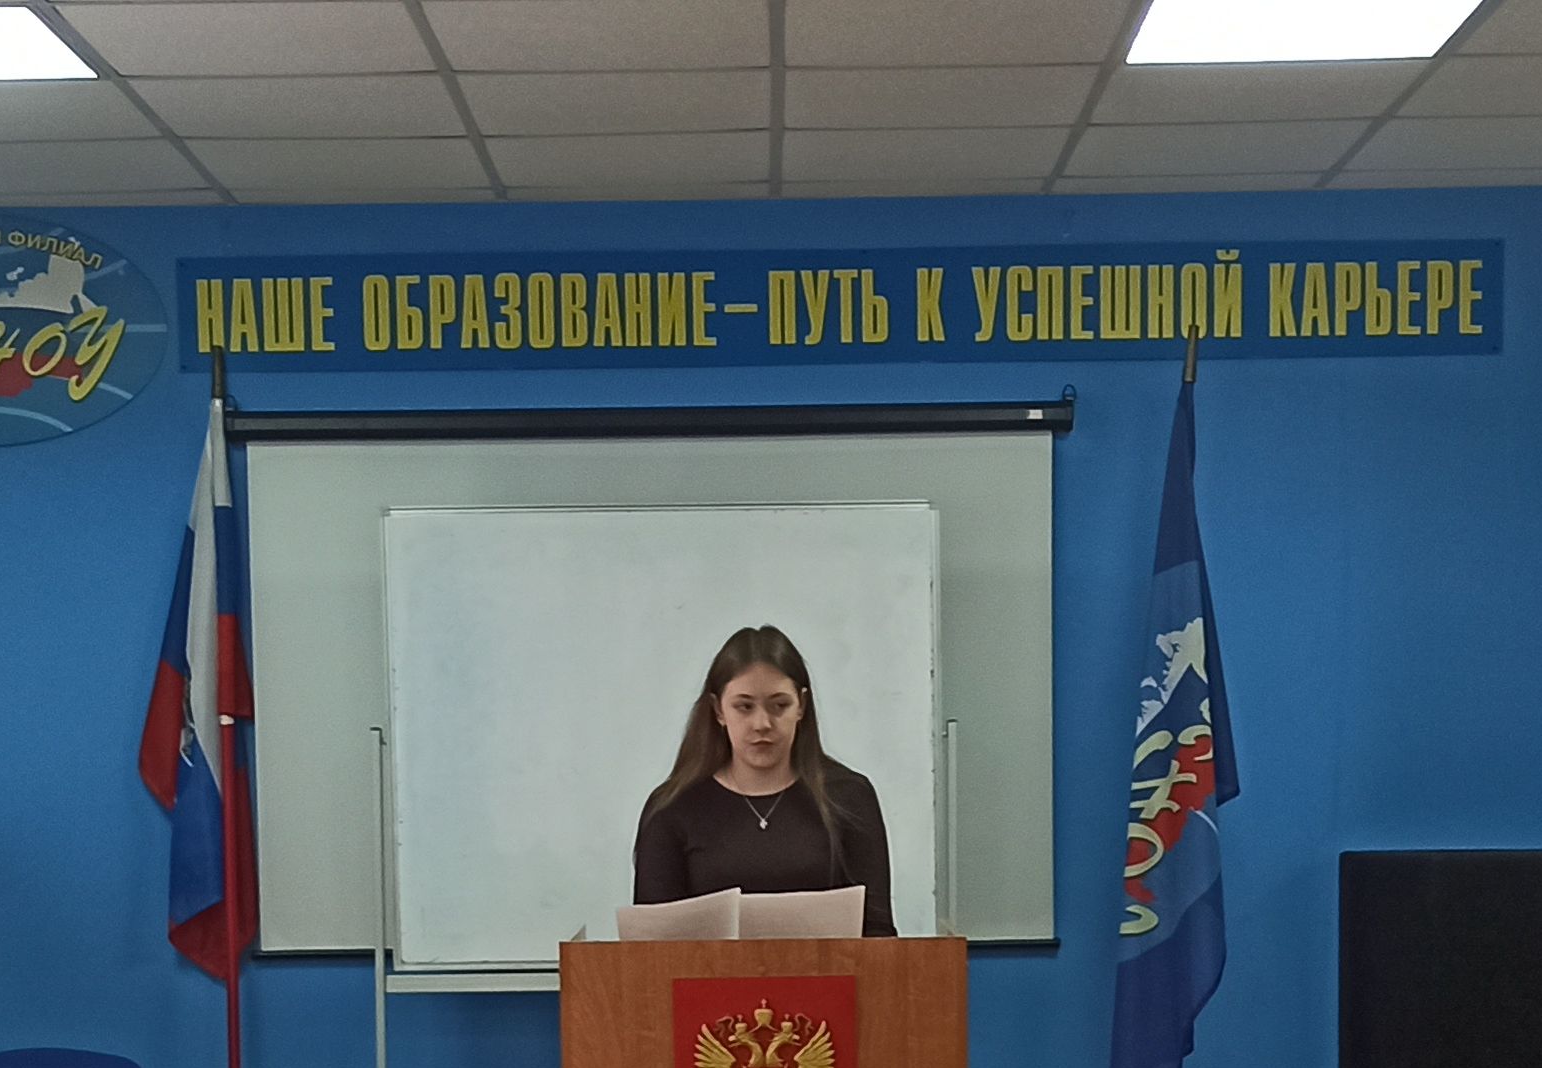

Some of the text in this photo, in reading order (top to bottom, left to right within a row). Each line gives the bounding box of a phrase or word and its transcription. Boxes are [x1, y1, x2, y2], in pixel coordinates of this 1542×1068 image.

[9, 230, 103, 270] ФИЛИАЛ
[195, 276, 336, 353] НАШЕ
[362, 271, 717, 352] ОБРАЗОВАНИЕ
[768, 267, 889, 346] ПУТЬ
[916, 267, 944, 343] К
[971, 249, 1243, 342] УСПЕШНОЙ
[1268, 258, 1484, 339] КАРЬЕРЕ
